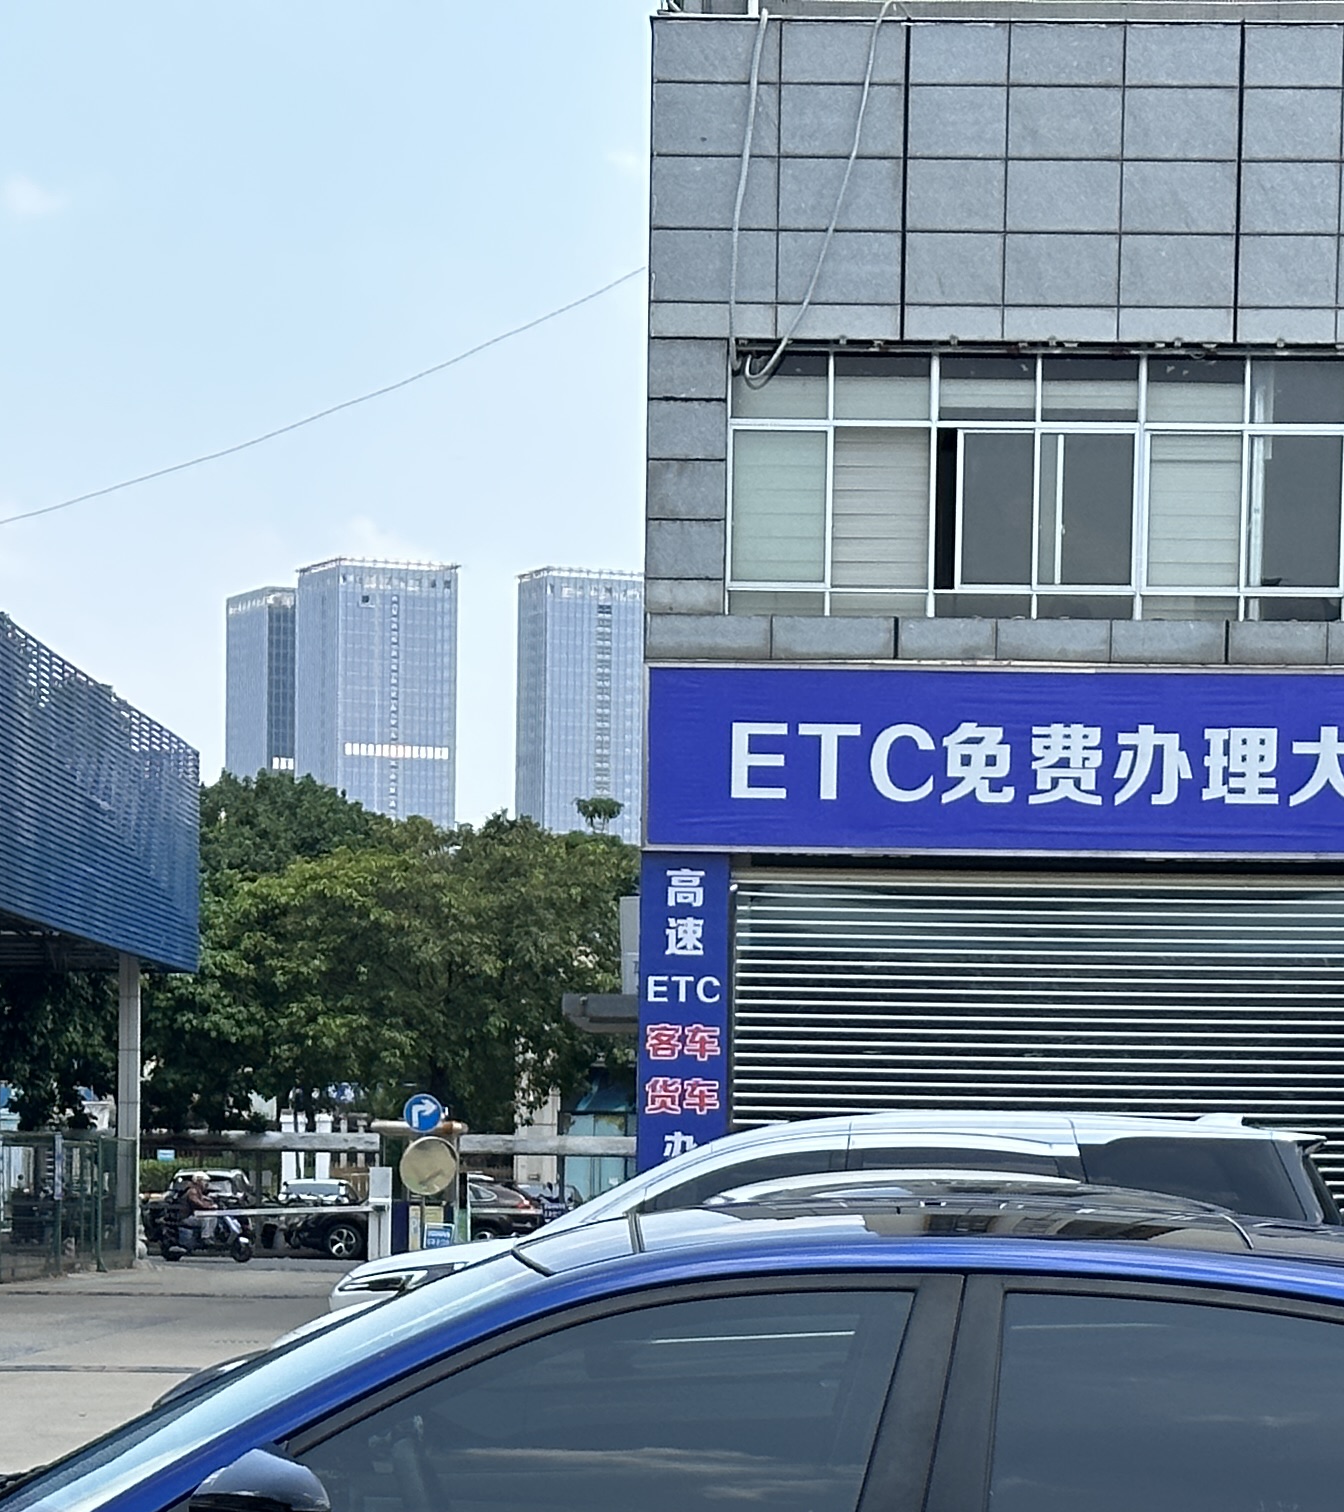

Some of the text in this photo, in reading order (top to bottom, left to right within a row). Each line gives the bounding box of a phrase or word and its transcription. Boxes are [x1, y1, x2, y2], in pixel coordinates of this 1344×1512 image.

[665, 869, 705, 955] 高速
[648, 976, 720, 1002] ETC
[646, 1024, 720, 1061] 客车
[645, 1077, 719, 1114] 货车
